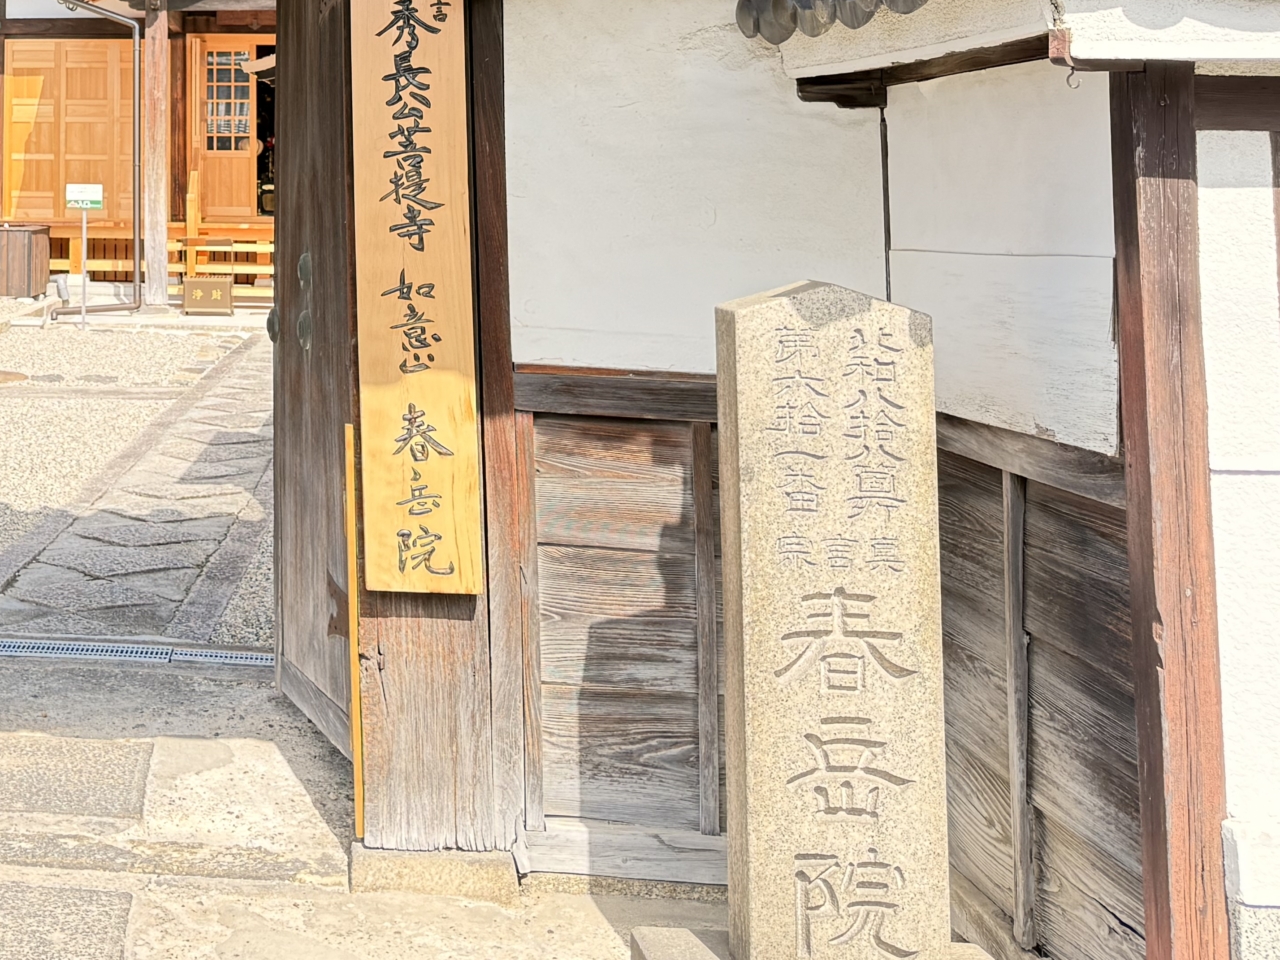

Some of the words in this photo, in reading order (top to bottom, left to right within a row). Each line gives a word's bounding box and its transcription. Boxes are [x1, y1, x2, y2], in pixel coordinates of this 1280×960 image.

[381, 268, 442, 374] 如意山
[392, 402, 455, 575] 春岳院
